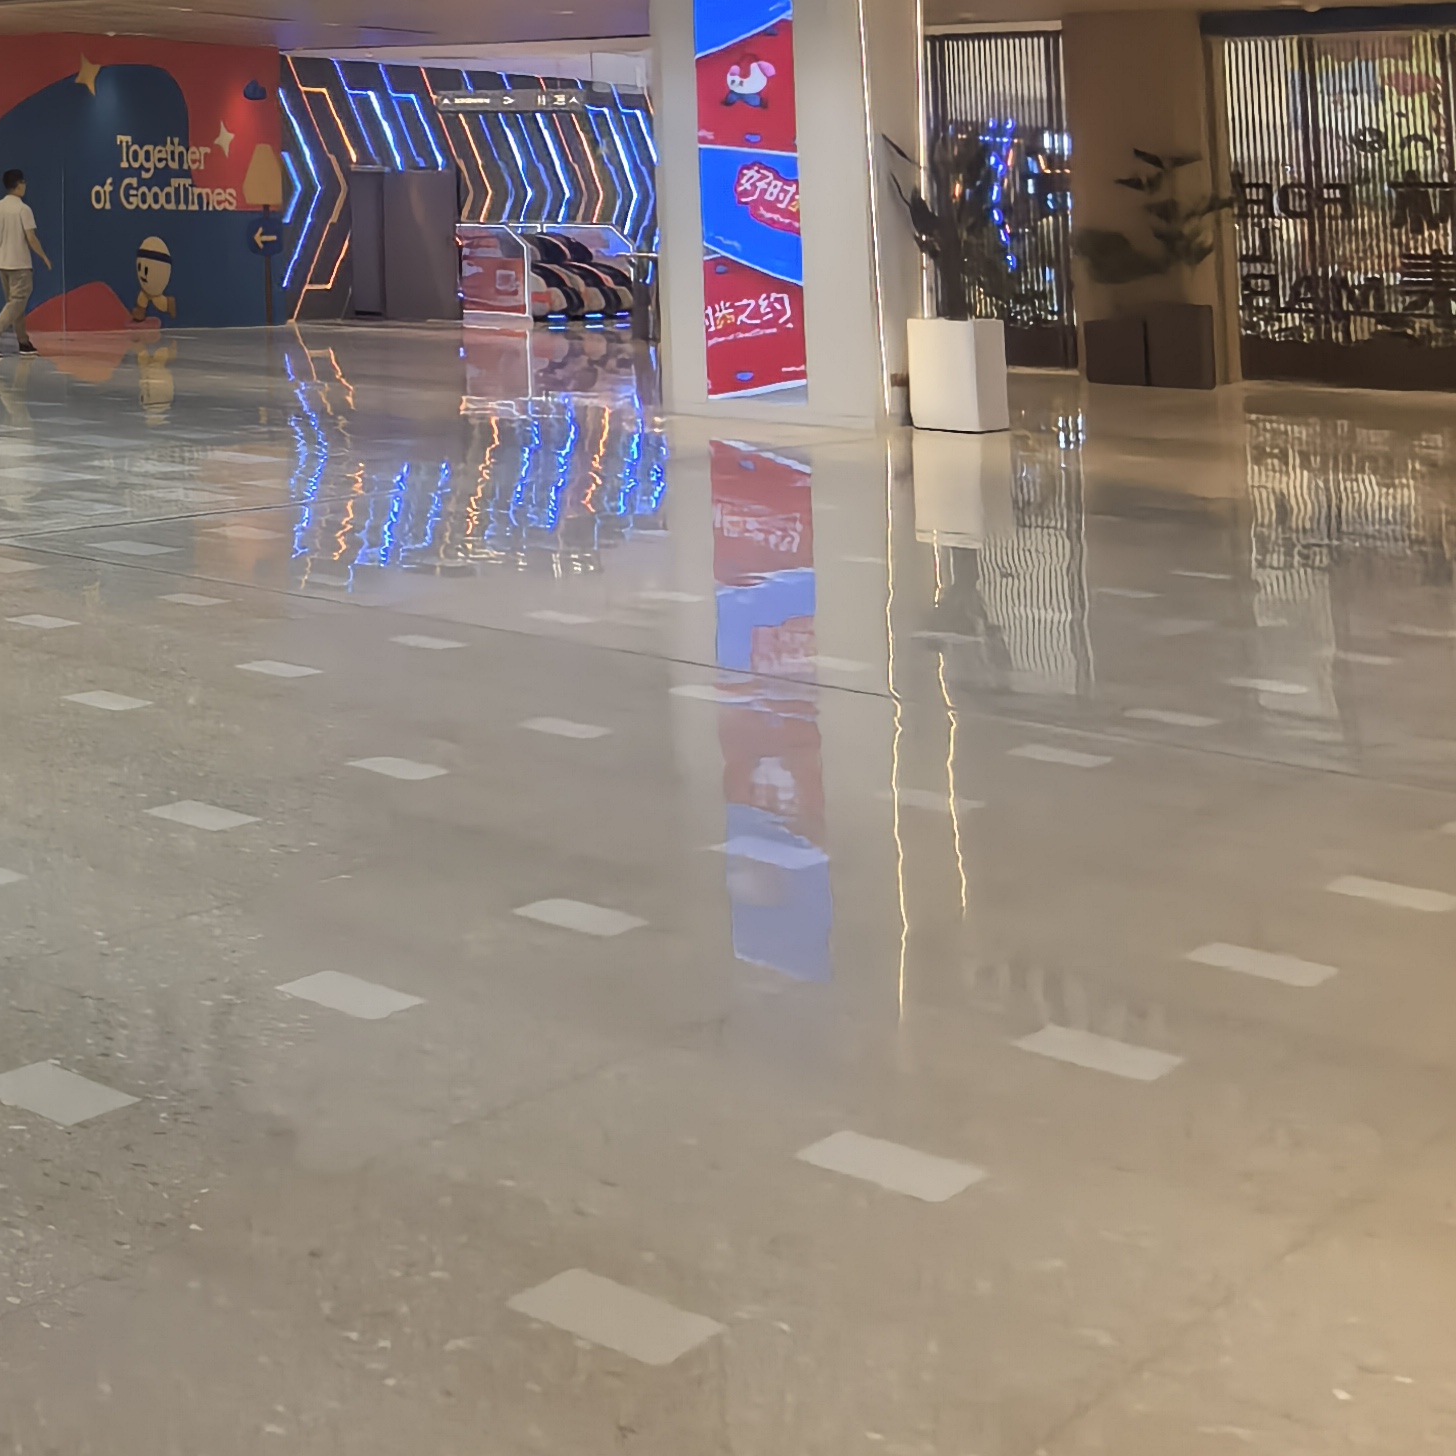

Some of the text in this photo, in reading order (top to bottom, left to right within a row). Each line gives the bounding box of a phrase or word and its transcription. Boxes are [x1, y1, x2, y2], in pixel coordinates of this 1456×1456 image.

[117, 135, 211, 178] Together
[91, 177, 237, 211] of GoodTimes
